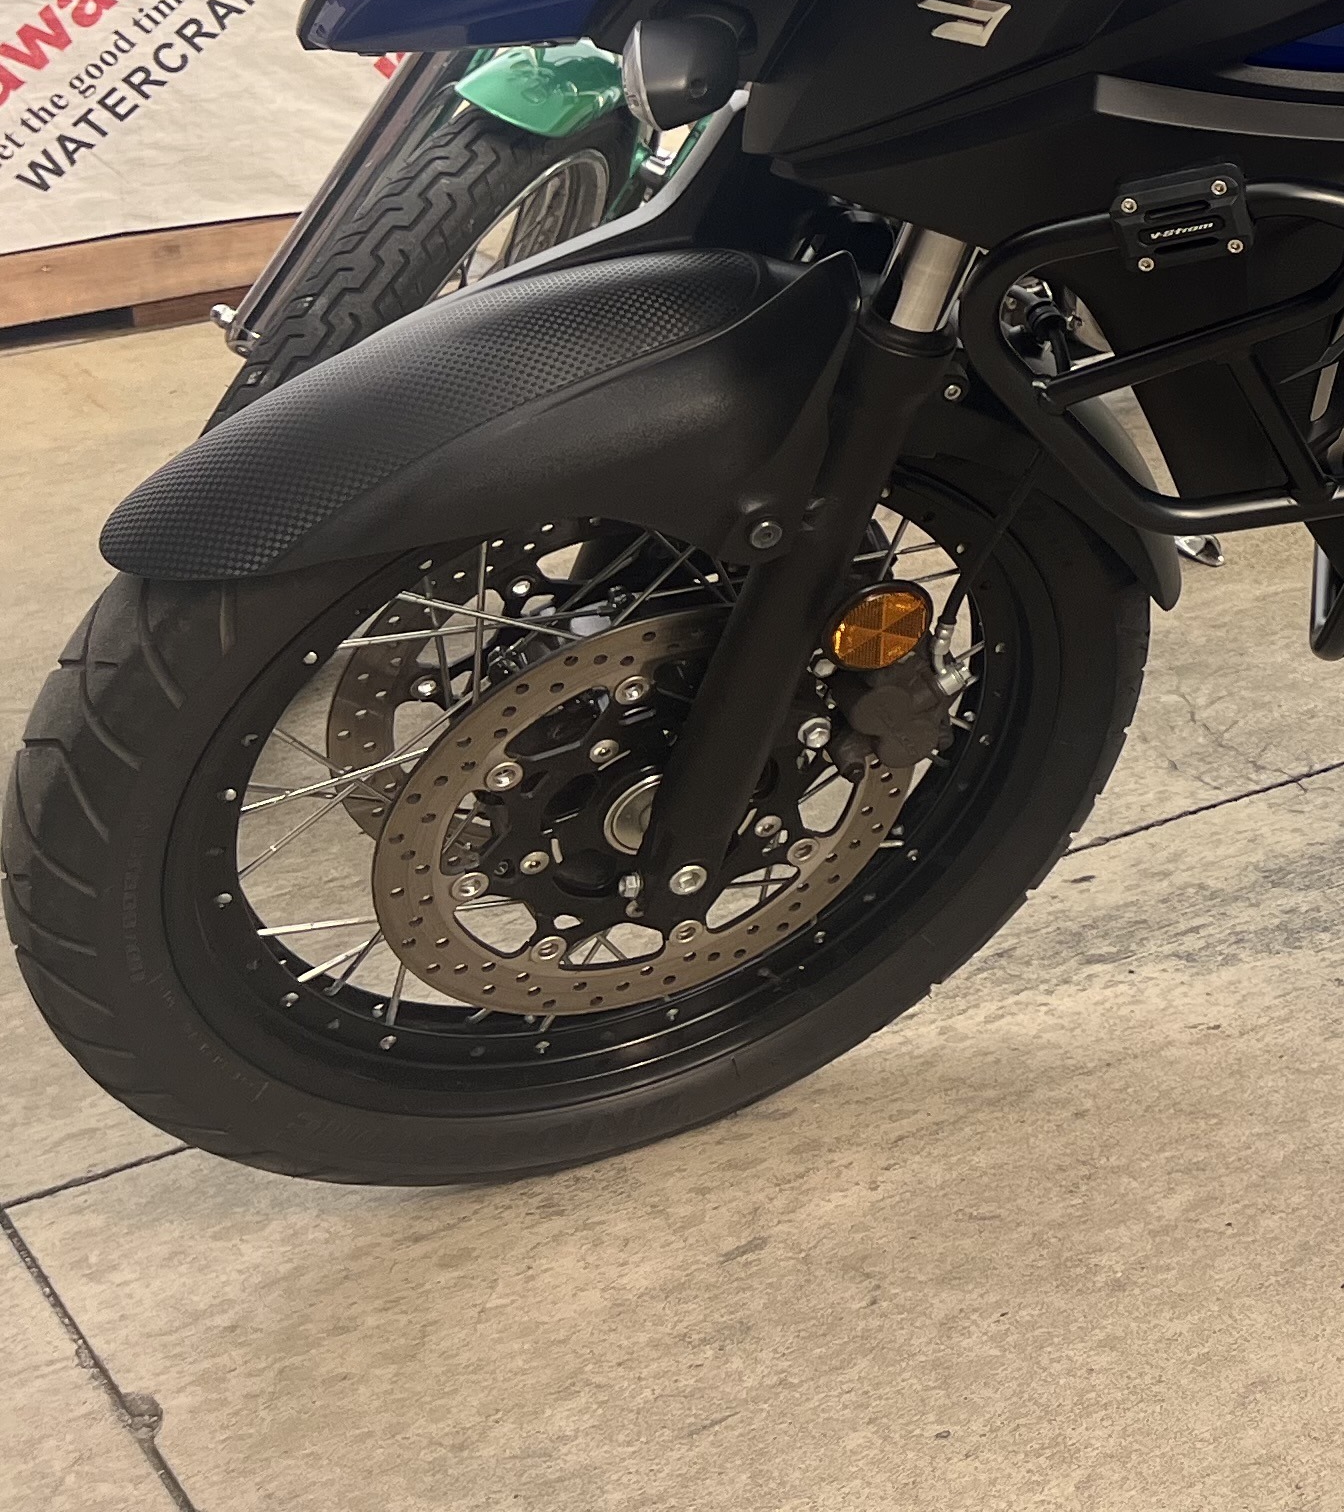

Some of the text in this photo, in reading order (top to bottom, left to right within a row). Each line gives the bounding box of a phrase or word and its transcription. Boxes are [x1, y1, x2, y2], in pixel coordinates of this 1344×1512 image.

[0, 130, 25, 169] et
[21, 90, 69, 137] the
[68, 30, 136, 99] good
